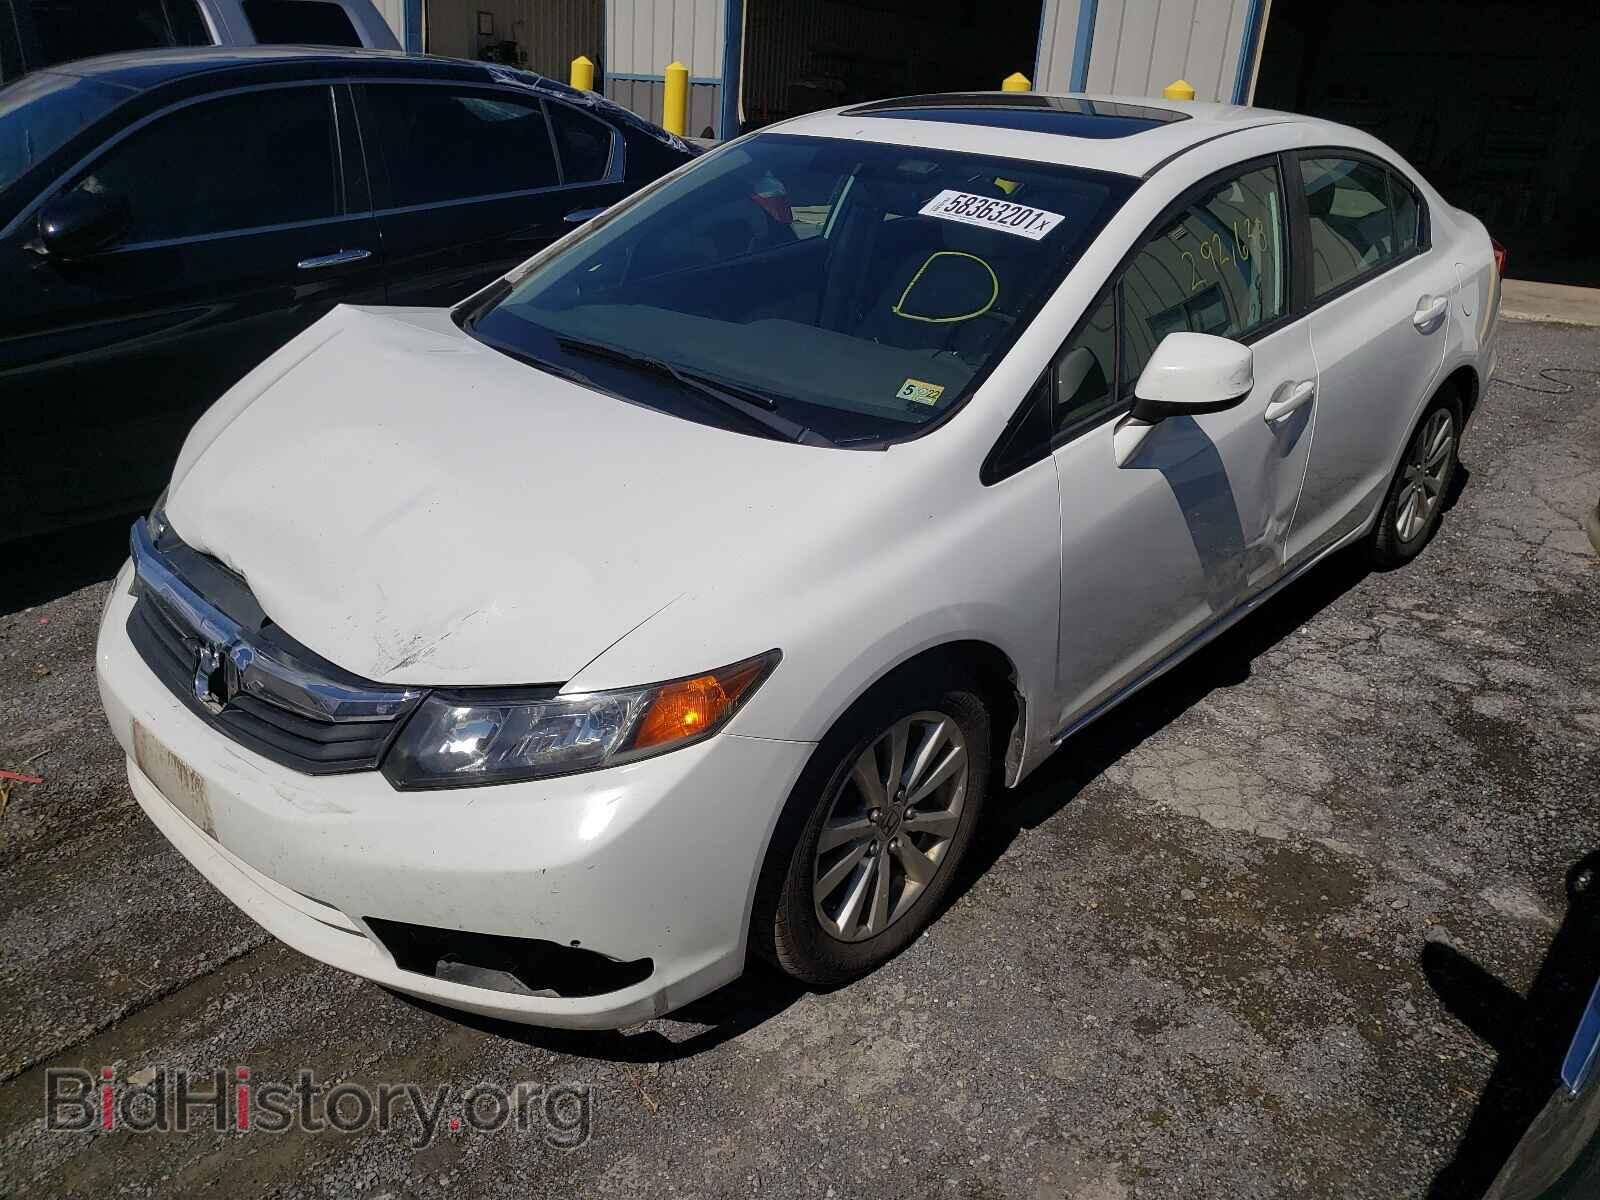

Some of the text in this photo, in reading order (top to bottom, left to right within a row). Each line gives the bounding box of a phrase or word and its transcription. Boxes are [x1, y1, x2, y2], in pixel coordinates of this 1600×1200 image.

[891, 251, 999, 323] D
[903, 384, 941, 400] 5 22
